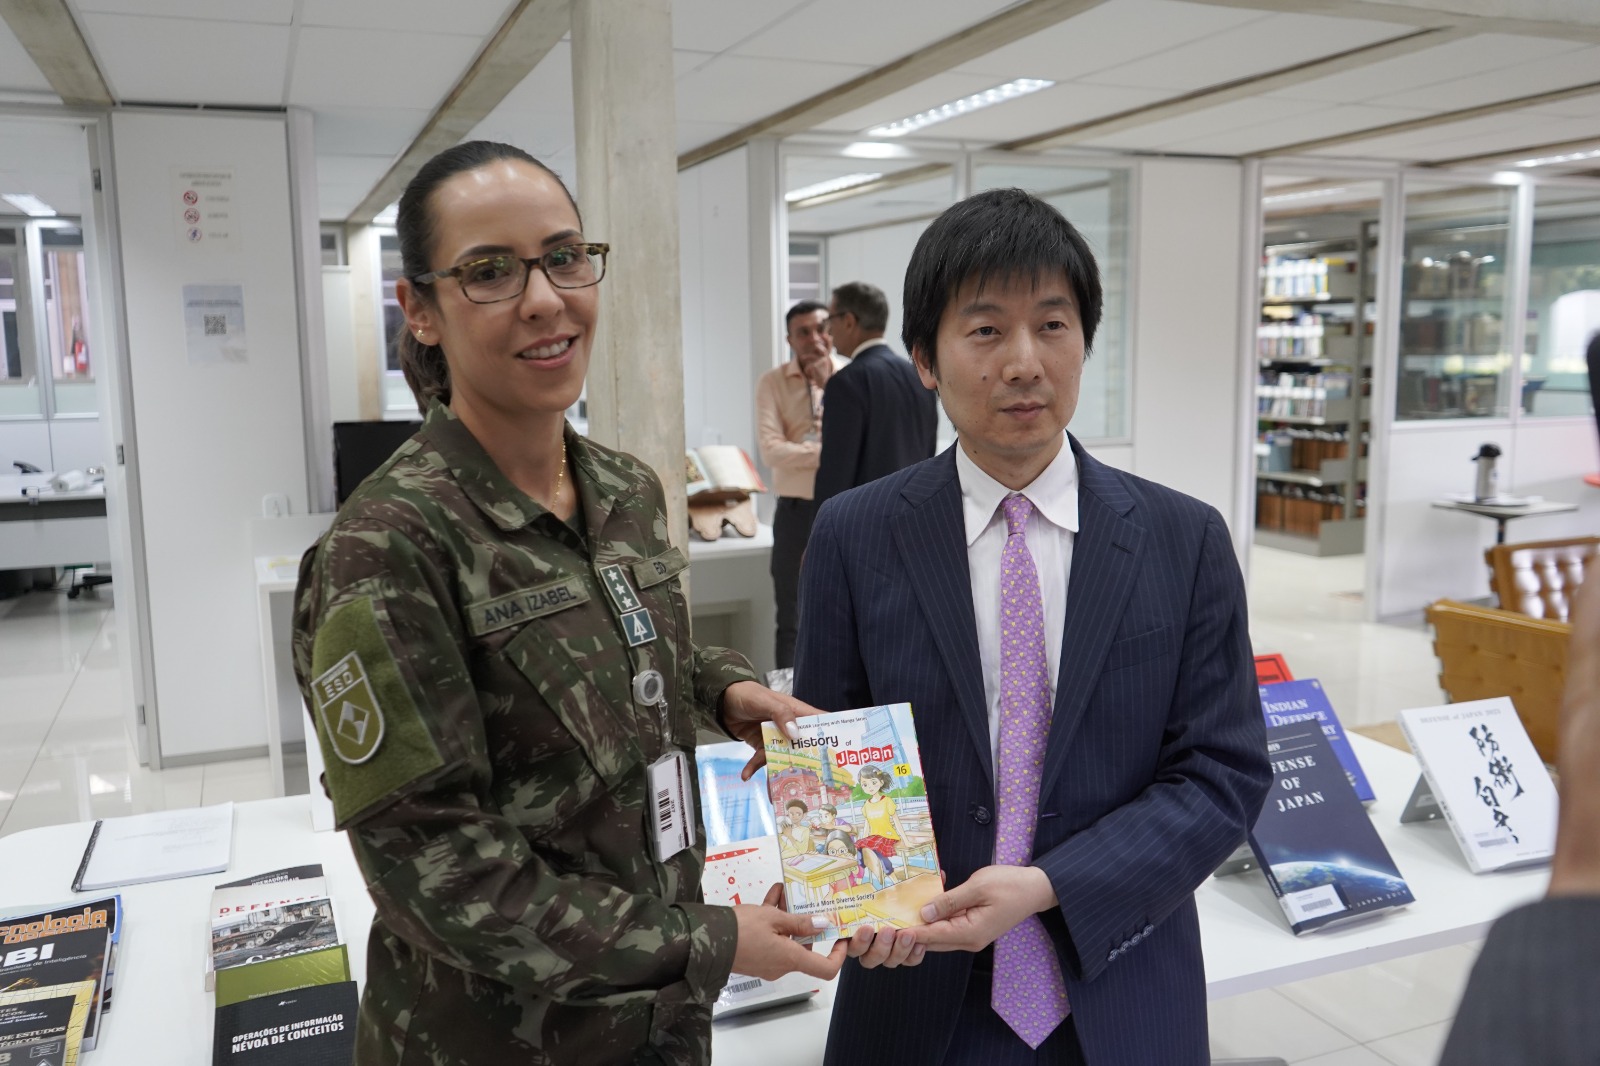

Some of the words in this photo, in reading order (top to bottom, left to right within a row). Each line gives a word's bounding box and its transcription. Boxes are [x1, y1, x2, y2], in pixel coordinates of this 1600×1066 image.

[484, 602, 524, 626] ANA
[526, 585, 577, 613] IZABEL
[324, 671, 354, 698] ESD
[1263, 699, 1309, 714] INDIAN
[771, 737, 784, 745] The
[790, 734, 839, 751] History
[836, 746, 893, 766] Japan
[1271, 754, 1317, 775] FENSE
[896, 765, 908, 776] 16
[1280, 776, 1301, 791] OF
[1276, 791, 1325, 813] JAPAN
[793, 902, 816, 911] Towards
[821, 899, 836, 907] More
[836, 896, 856, 905] Diverse
[856, 892, 875, 902] Society
[0, 943, 55, 967] BI
[16, 1026, 66, 1039] ESTUDOS
[232, 1026, 278, 1044] OPERAÇÕES
[279, 1024, 290, 1034] DE
[291, 1013, 343, 1031] INFORMAÇÃO
[232, 1037, 269, 1054] NÉVOA
[271, 1033, 285, 1045] DE
[287, 1021, 344, 1041] CONCEITOS
